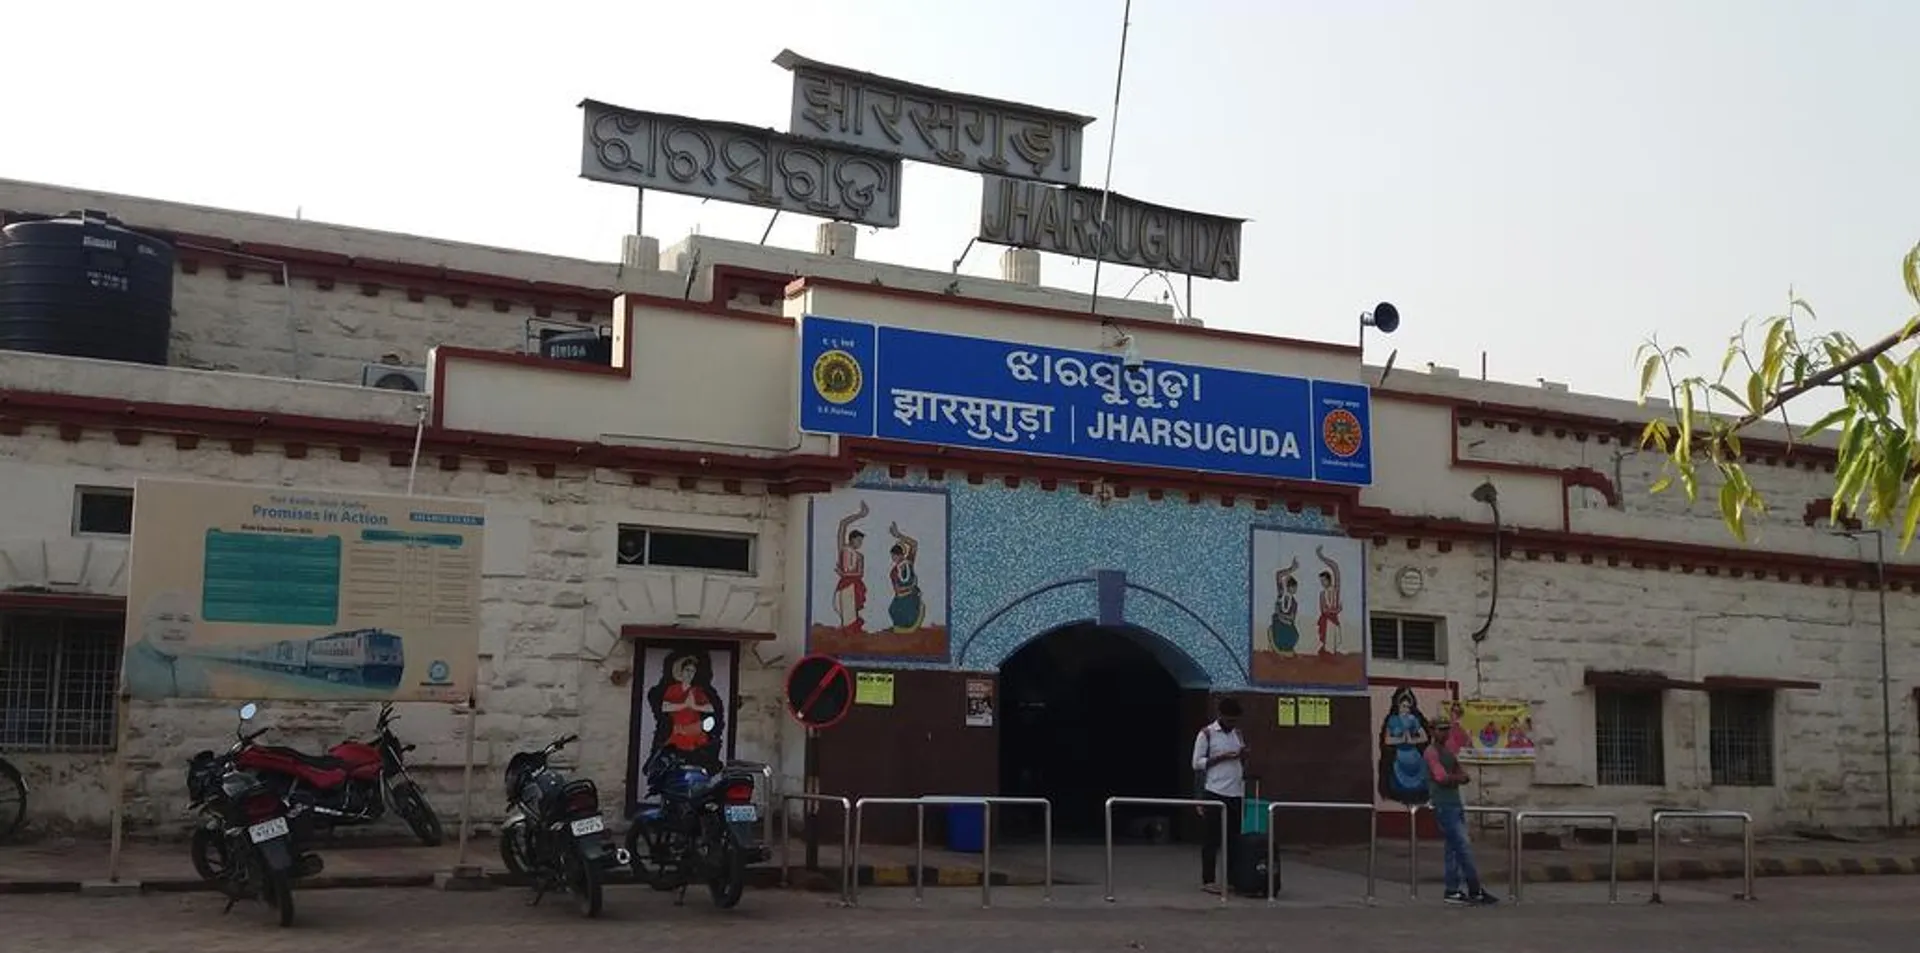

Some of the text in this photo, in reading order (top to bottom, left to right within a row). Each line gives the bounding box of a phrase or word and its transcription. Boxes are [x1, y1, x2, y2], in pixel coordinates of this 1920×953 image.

[802, 74, 1072, 177] झारसुगुड़ा
[983, 178, 1239, 279] JHARSUGUDA
[1006, 351, 1200, 408] ଝାରସୁଗୁଡ଼ା
[891, 388, 1055, 442] झारसुगुड़ा
[1087, 411, 1300, 459] JHARSUGUDA
[253, 504, 320, 521] Promises
[341, 509, 388, 525] Action
